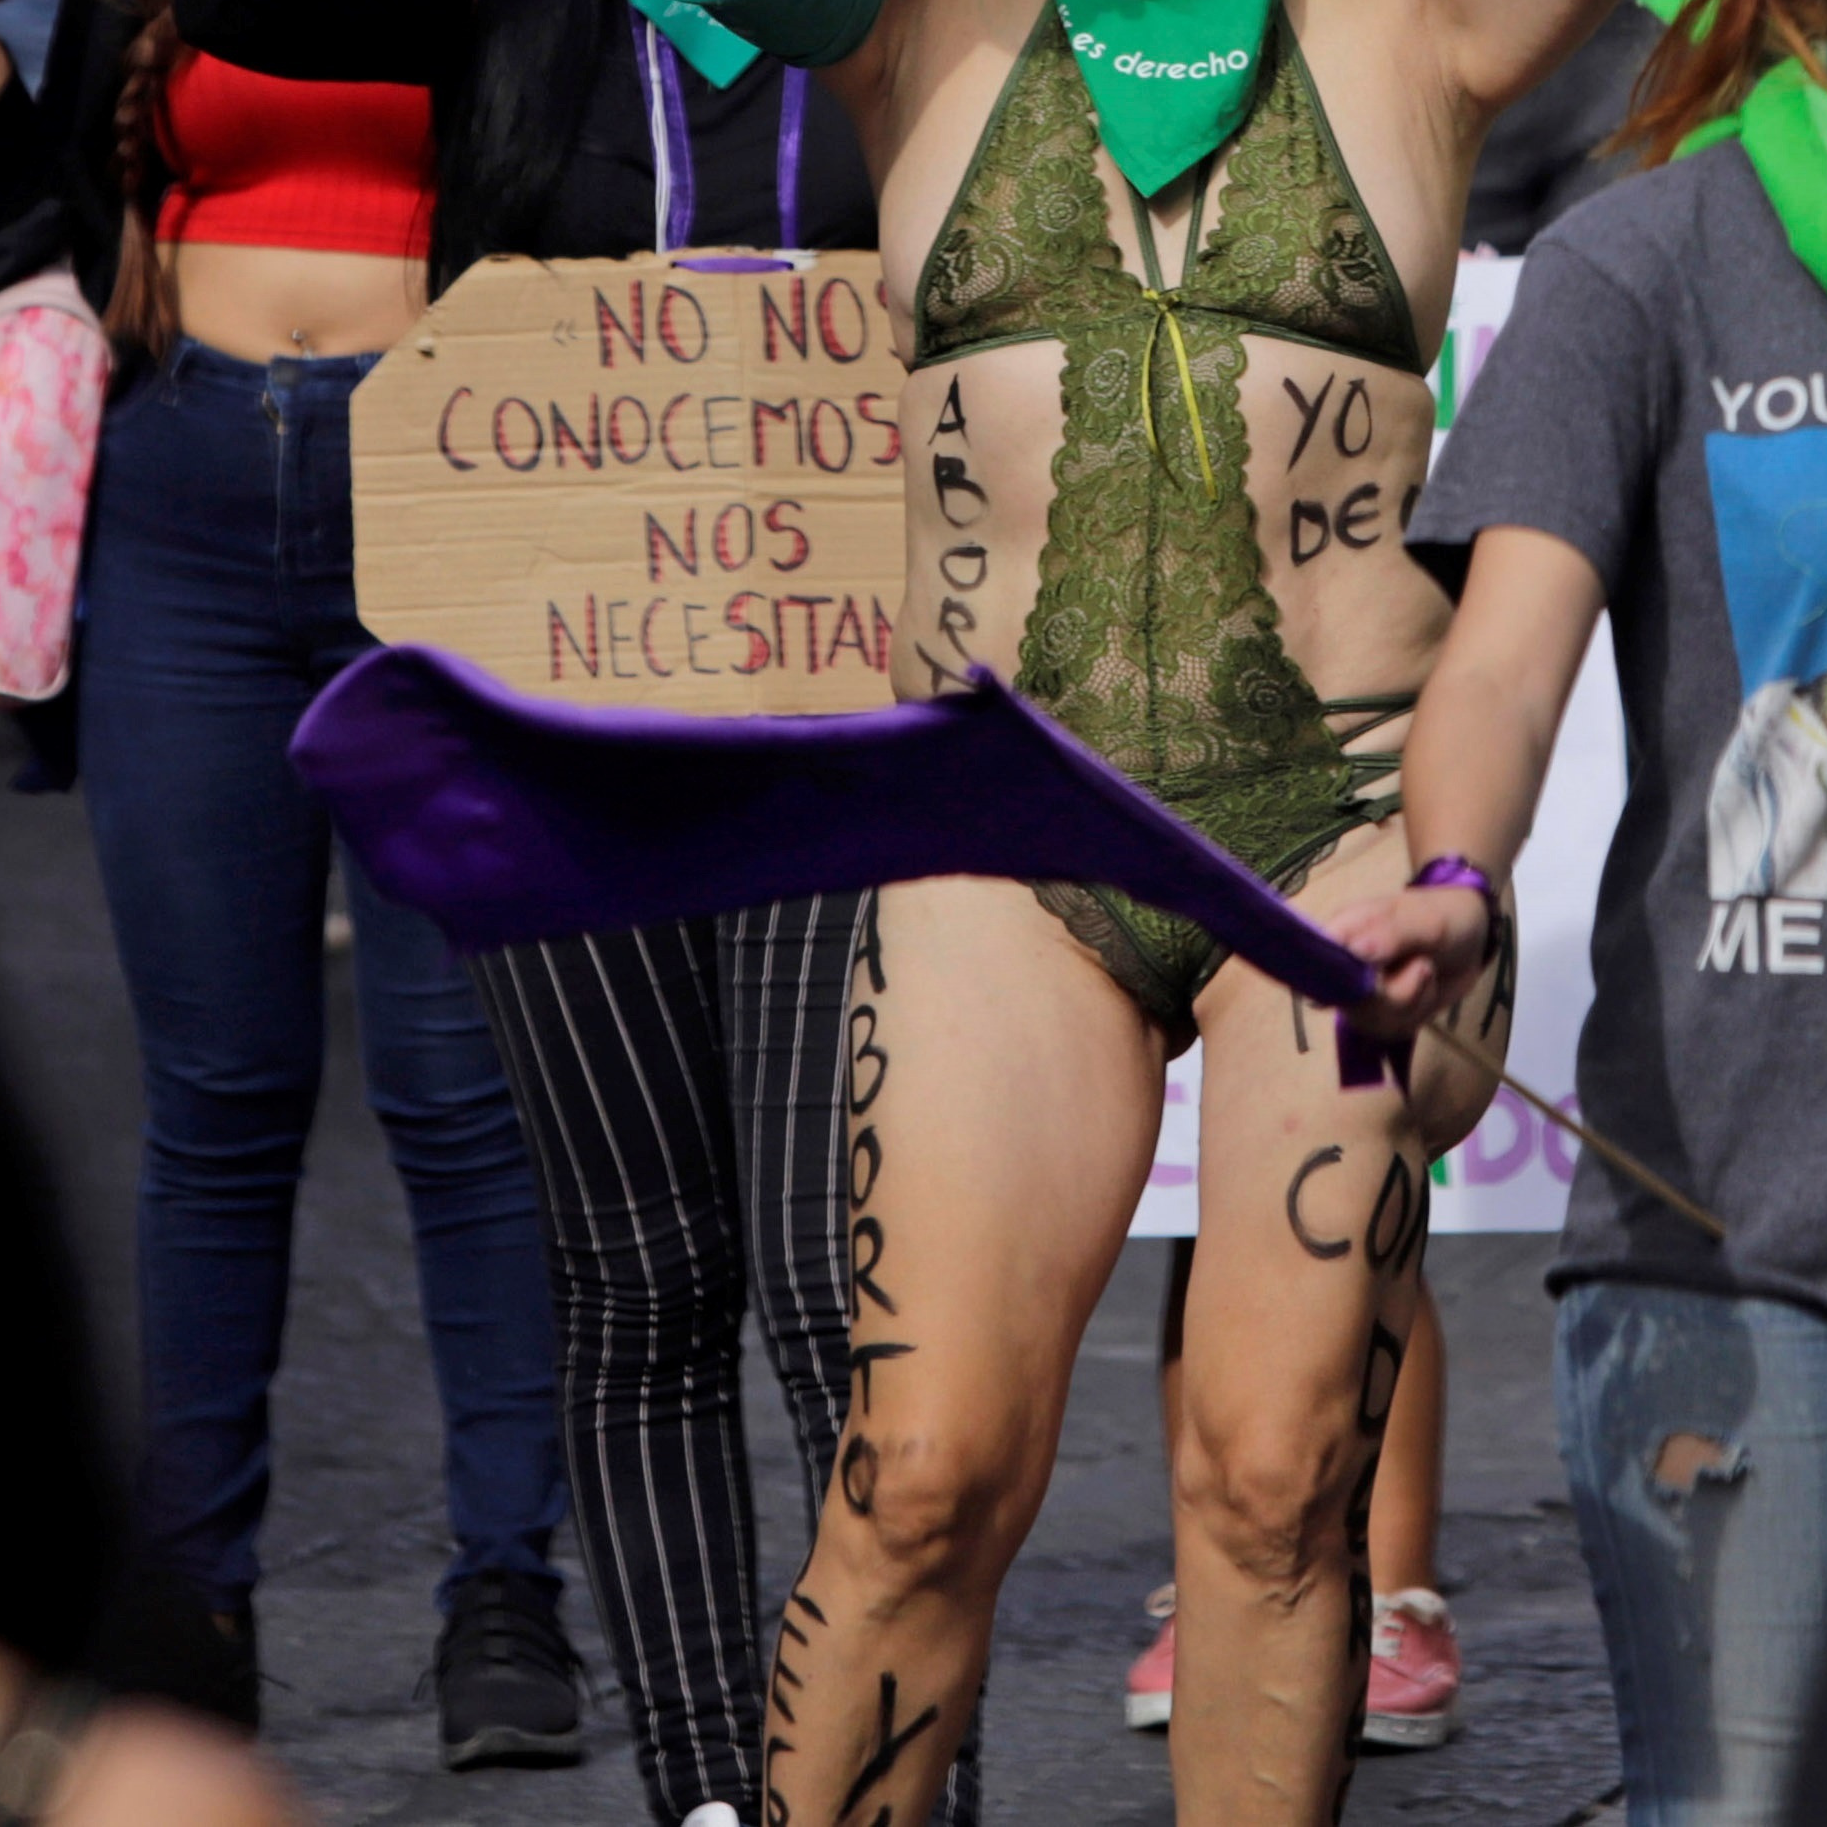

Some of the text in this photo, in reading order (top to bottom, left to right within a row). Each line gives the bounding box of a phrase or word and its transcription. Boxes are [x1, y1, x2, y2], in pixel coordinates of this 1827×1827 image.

[1072, 31, 1249, 80] es derecho
[759, 277, 898, 364] NO
[437, 386, 902, 472] CONOCEMOS
[1282, 372, 1374, 473] YO
[644, 499, 811, 583] NOS
[1698, 894, 1826, 974] ME
